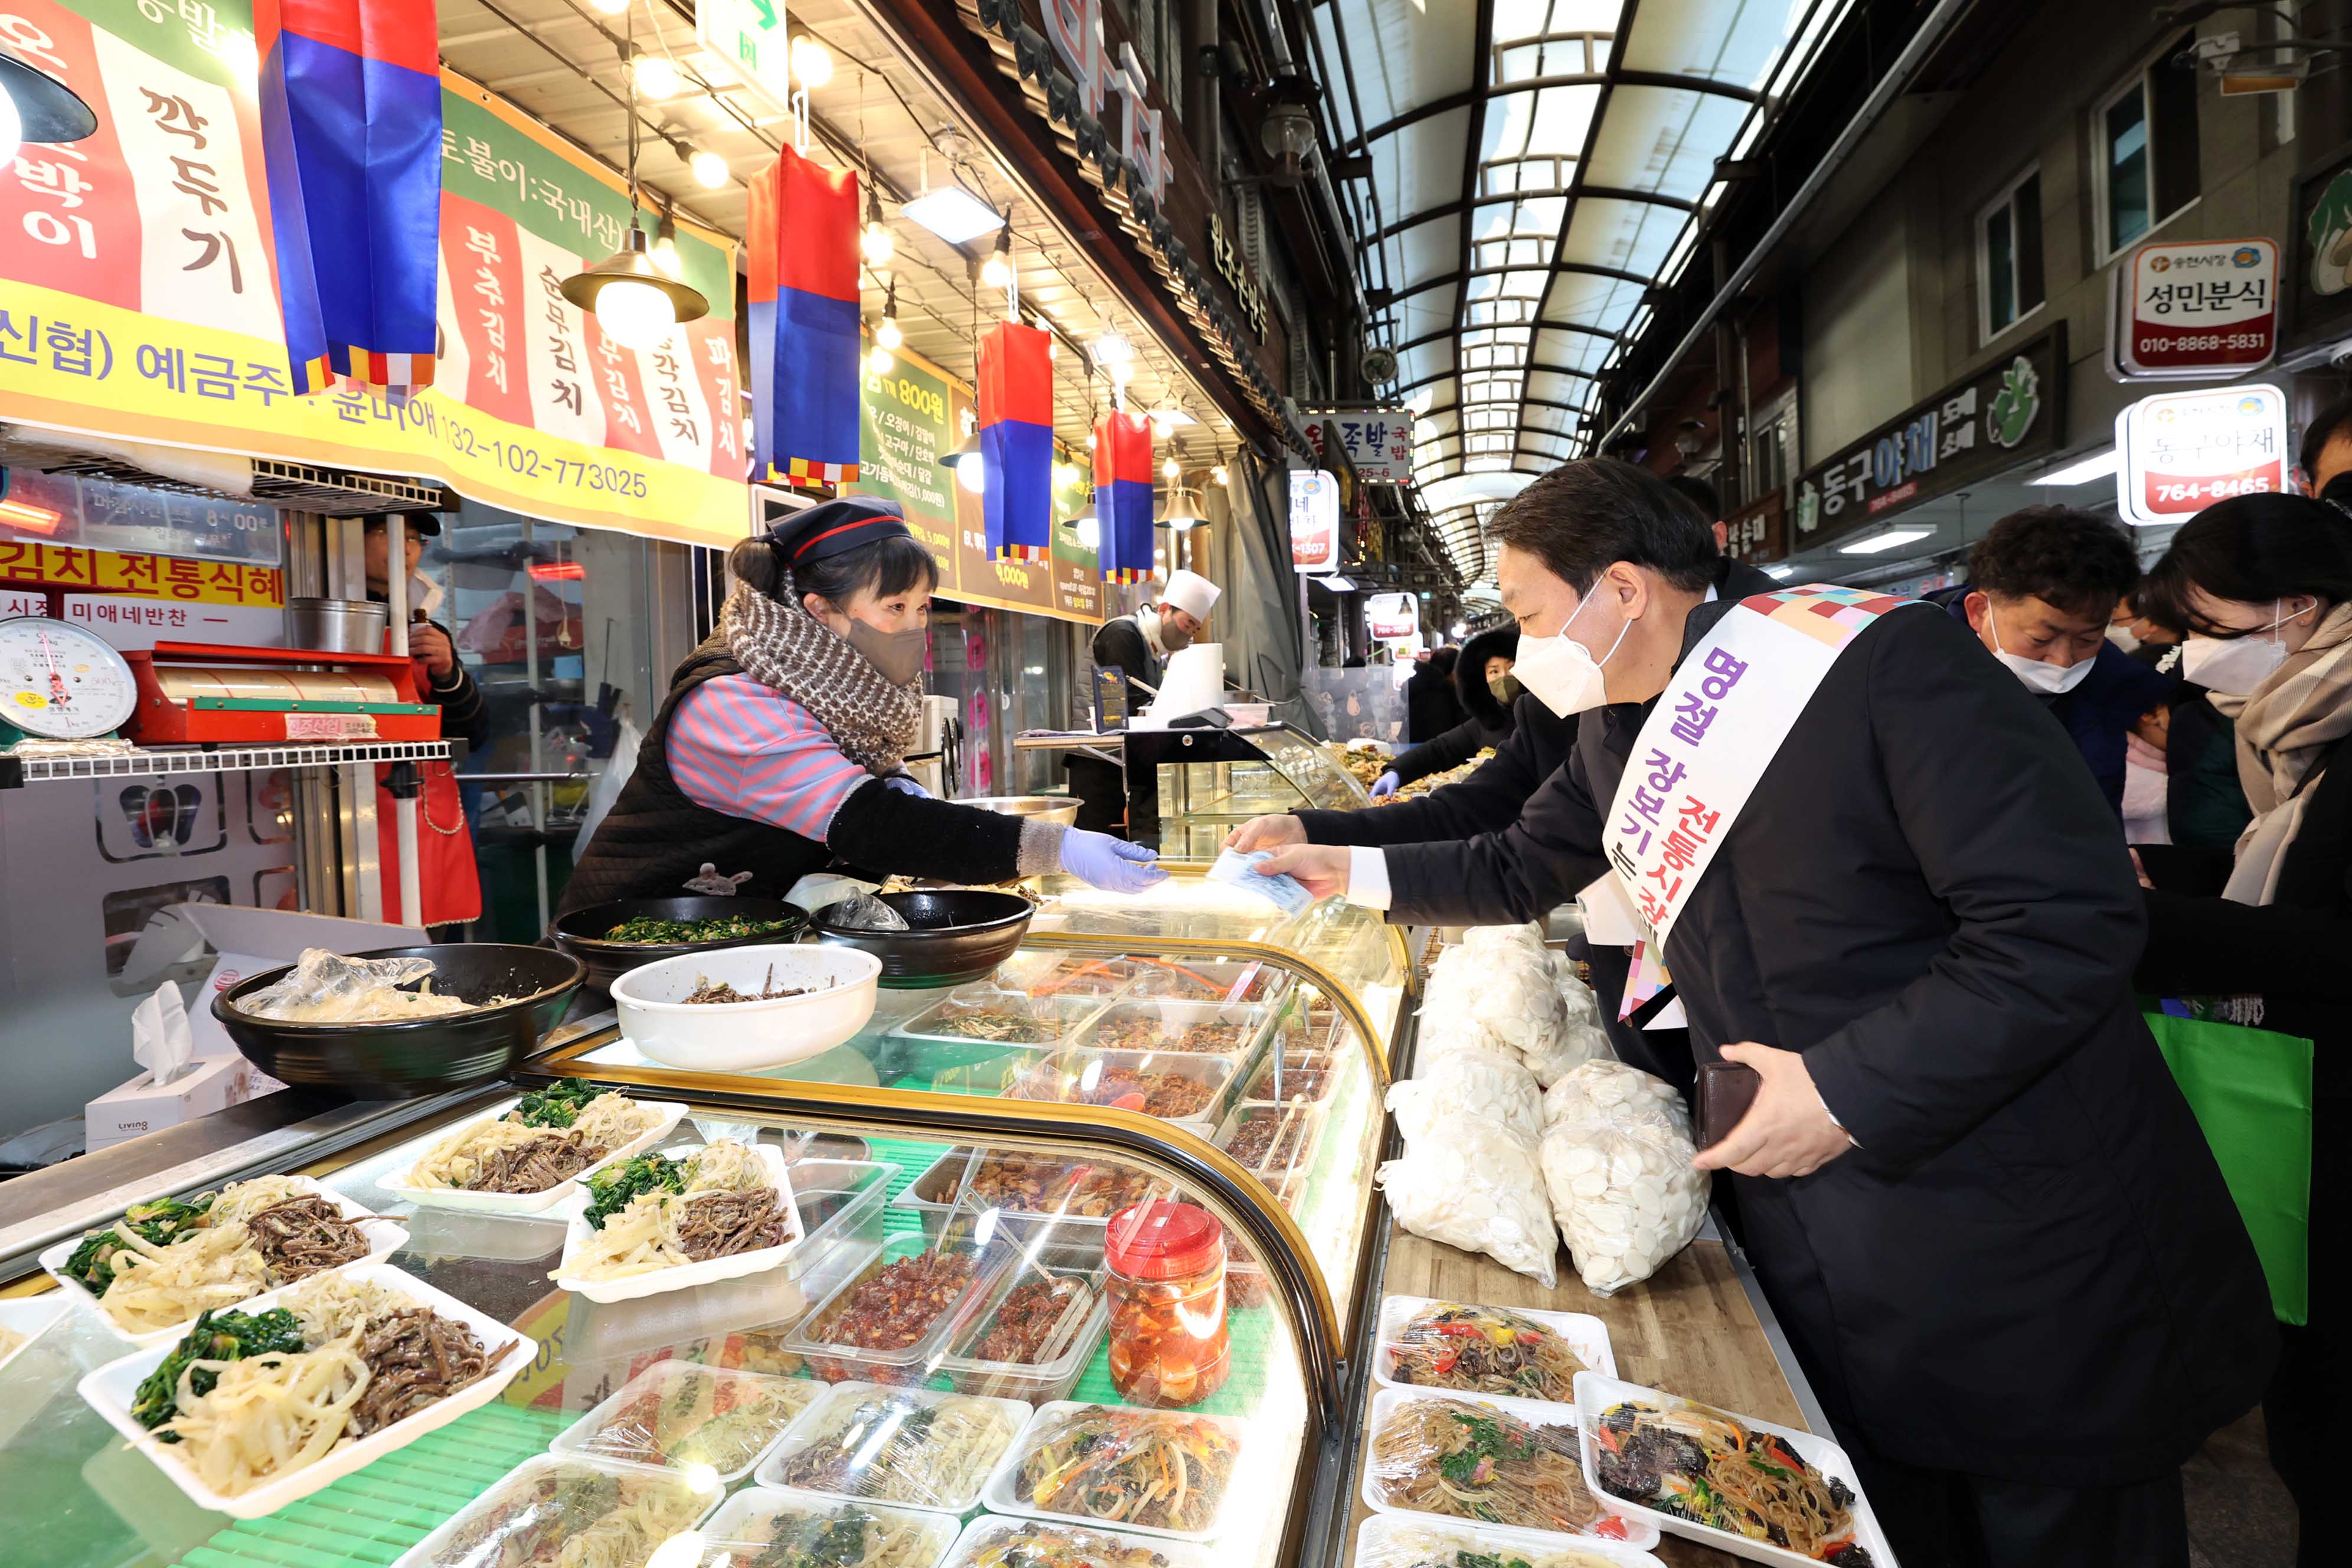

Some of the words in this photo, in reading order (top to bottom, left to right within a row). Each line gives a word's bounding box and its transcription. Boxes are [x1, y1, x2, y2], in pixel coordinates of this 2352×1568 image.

[0, 14, 97, 260] 오박이
[139, 86, 243, 295] 깍두기
[465, 225, 508, 394] 부추김치
[2140, 333, 2265, 353] 010-8868-5831
[2144, 279, 2266, 314] 성민분식
[136, 343, 289, 407] 예금주
[442, 415, 648, 498] 132-102-773025
[597, 332, 642, 435] 무김치
[652, 338, 700, 446] 각김치
[704, 336, 737, 460] 파김치
[899, 378, 944, 424] 800원
[1823, 411, 1939, 516] 동구야채
[2156, 477, 2270, 502] 764-8465
[0, 541, 97, 586] 김치
[119, 553, 284, 605] 전통식혜
[72, 602, 187, 627] 미애네반찬
[1670, 647, 1749, 747] 명절
[1611, 747, 1687, 881] 장보기는
